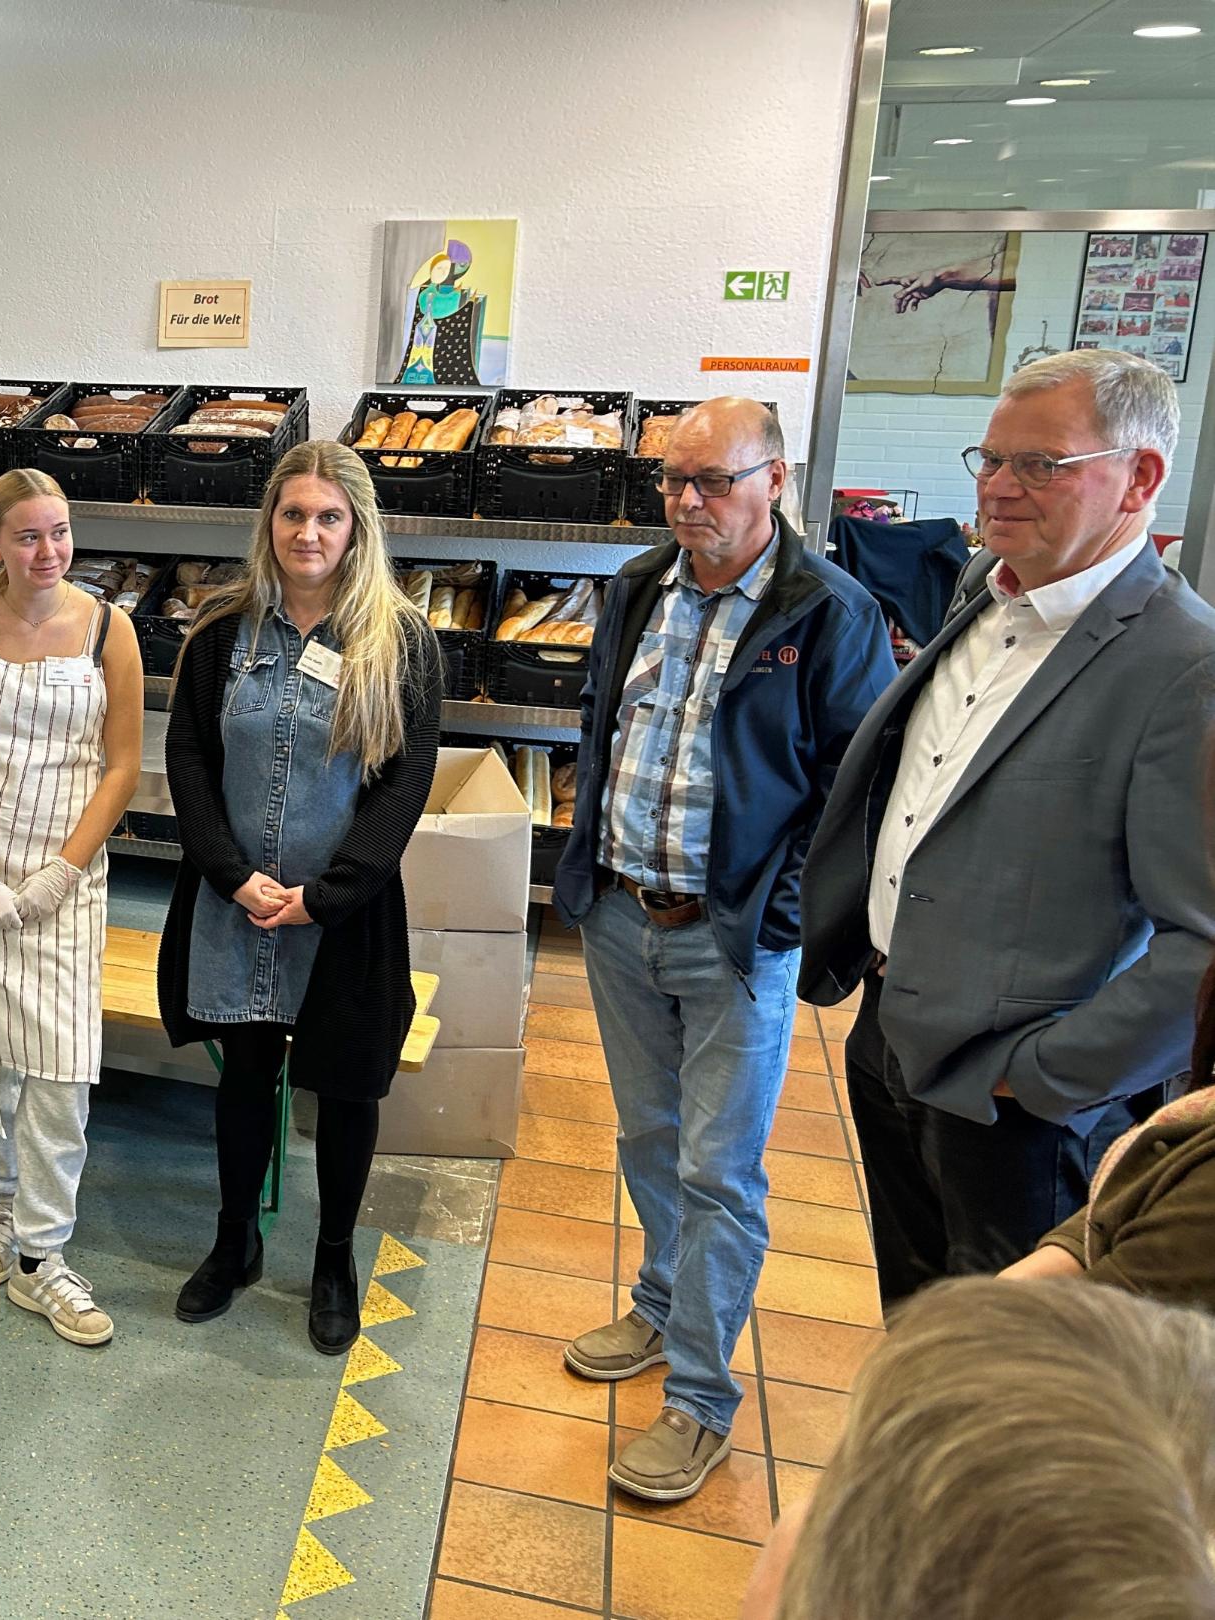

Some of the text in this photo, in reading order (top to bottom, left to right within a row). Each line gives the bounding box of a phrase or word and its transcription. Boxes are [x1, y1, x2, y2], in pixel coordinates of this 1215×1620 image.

[193, 293, 219, 305] Brot
[170, 313, 241, 325] Für die Welt
[710, 360, 799, 371] PERSONALRAUM
